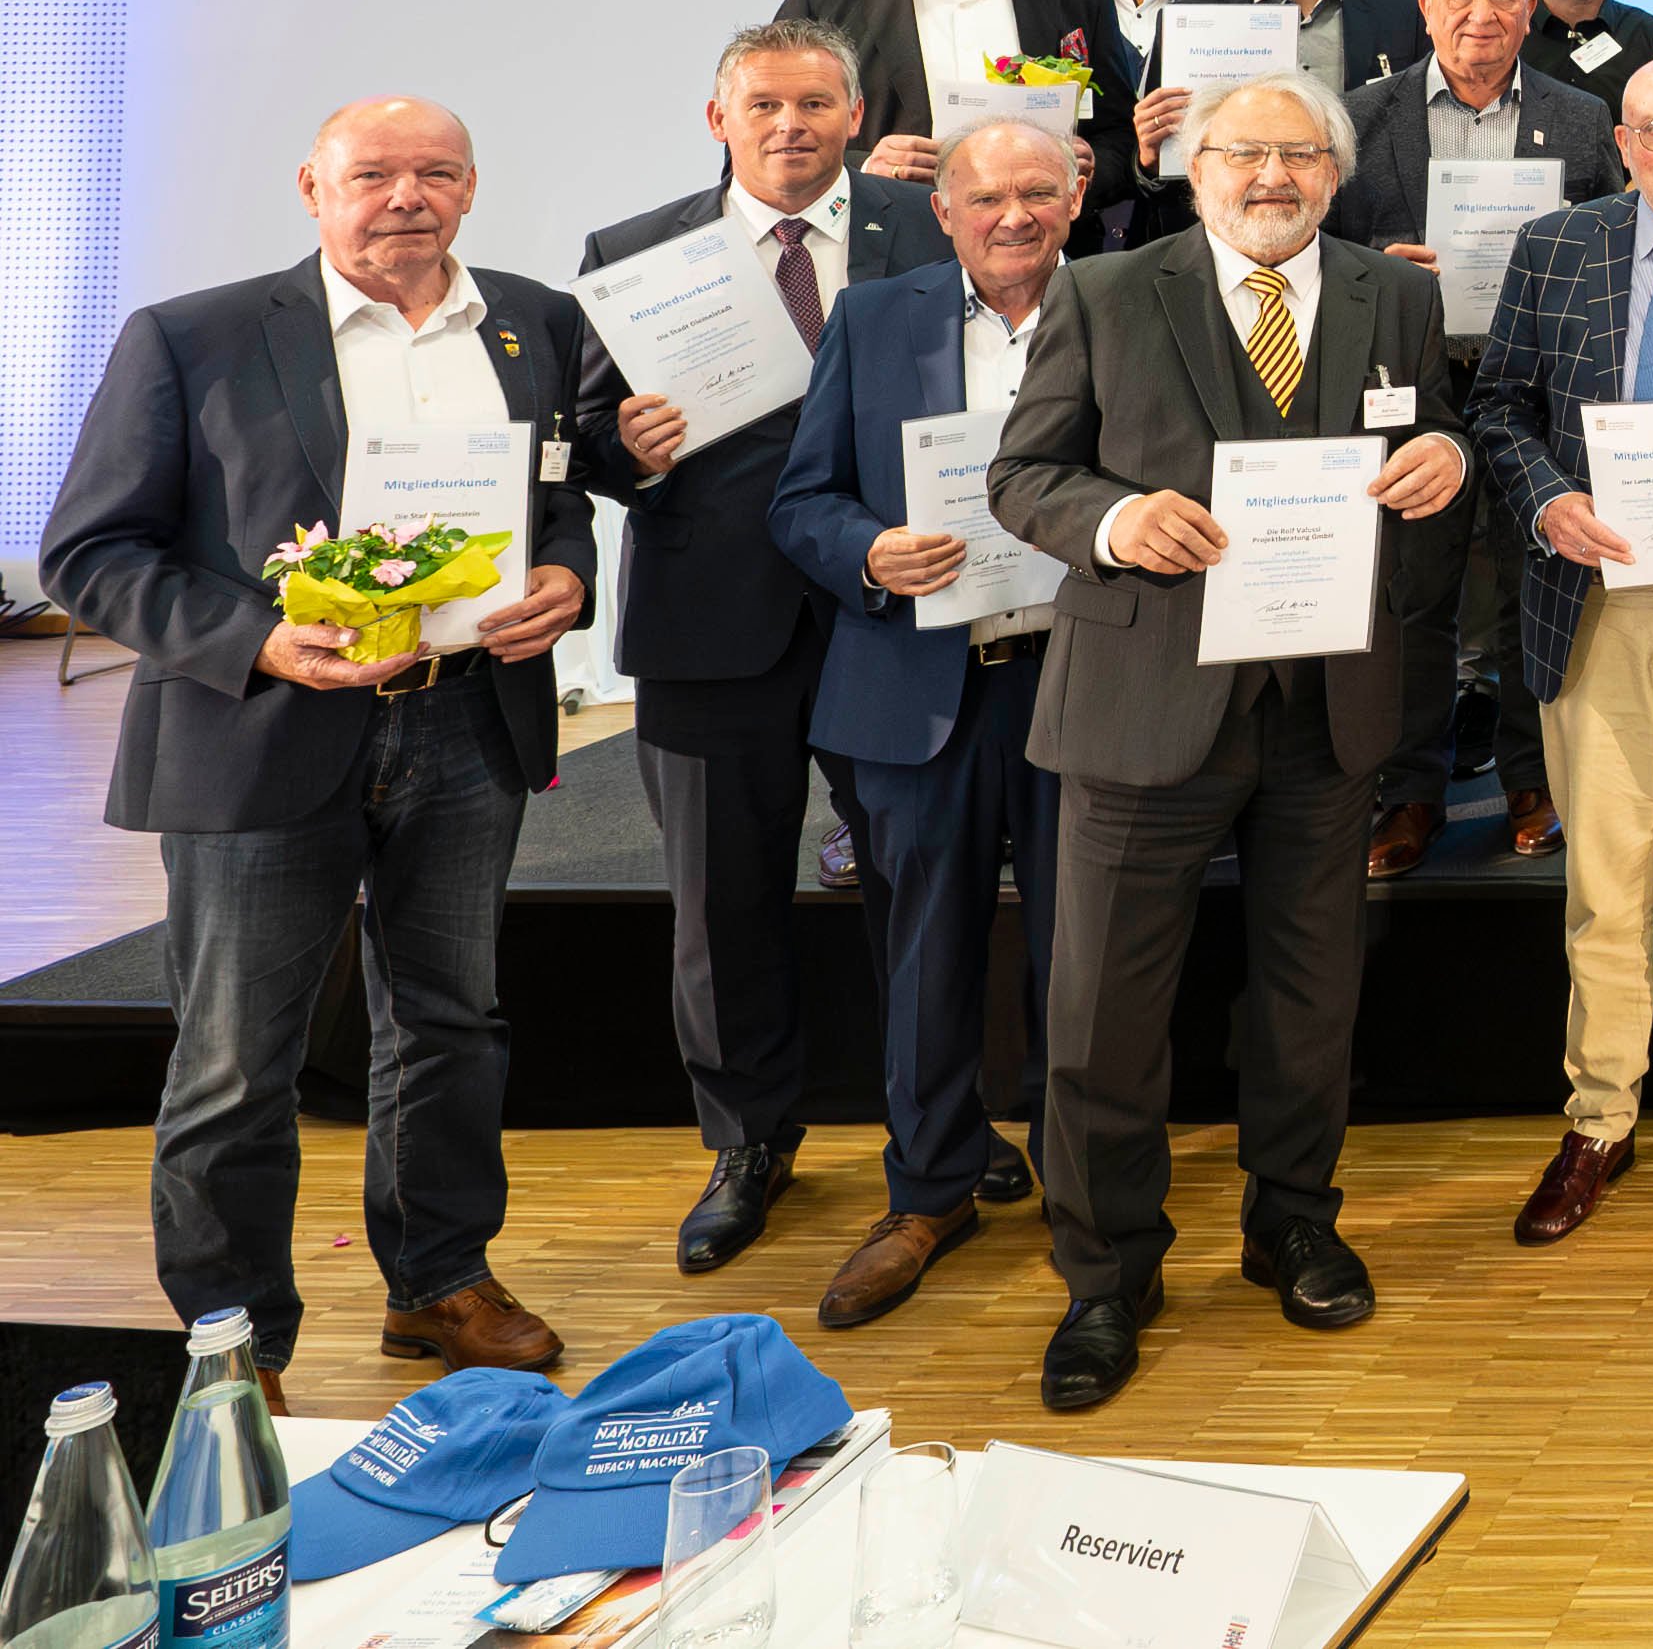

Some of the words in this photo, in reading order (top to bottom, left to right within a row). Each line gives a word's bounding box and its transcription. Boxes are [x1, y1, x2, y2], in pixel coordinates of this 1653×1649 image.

[1454, 203, 1537, 214] Mitgliedsurkunde
[629, 273, 733, 323] Mitgliedsurkunde
[938, 462, 989, 479] Mitglied
[384, 477, 497, 492] Mitgliedsurkunde
[1245, 493, 1348, 508] Mitgliedsurkunde
[394, 513, 409, 521] Die
[1266, 528, 1279, 536] Die
[595, 1423, 633, 1441] NAH
[617, 1426, 709, 1451] MOBILITÄT
[368, 1432, 421, 1469] MOBILITÄT
[585, 1459, 636, 1476] EINFACH
[638, 1453, 705, 1471] MACHEN!
[1059, 1524, 1186, 1575] Reserviert
[182, 1554, 284, 1621] SELTERS
[212, 1605, 265, 1637] CLASSIC
